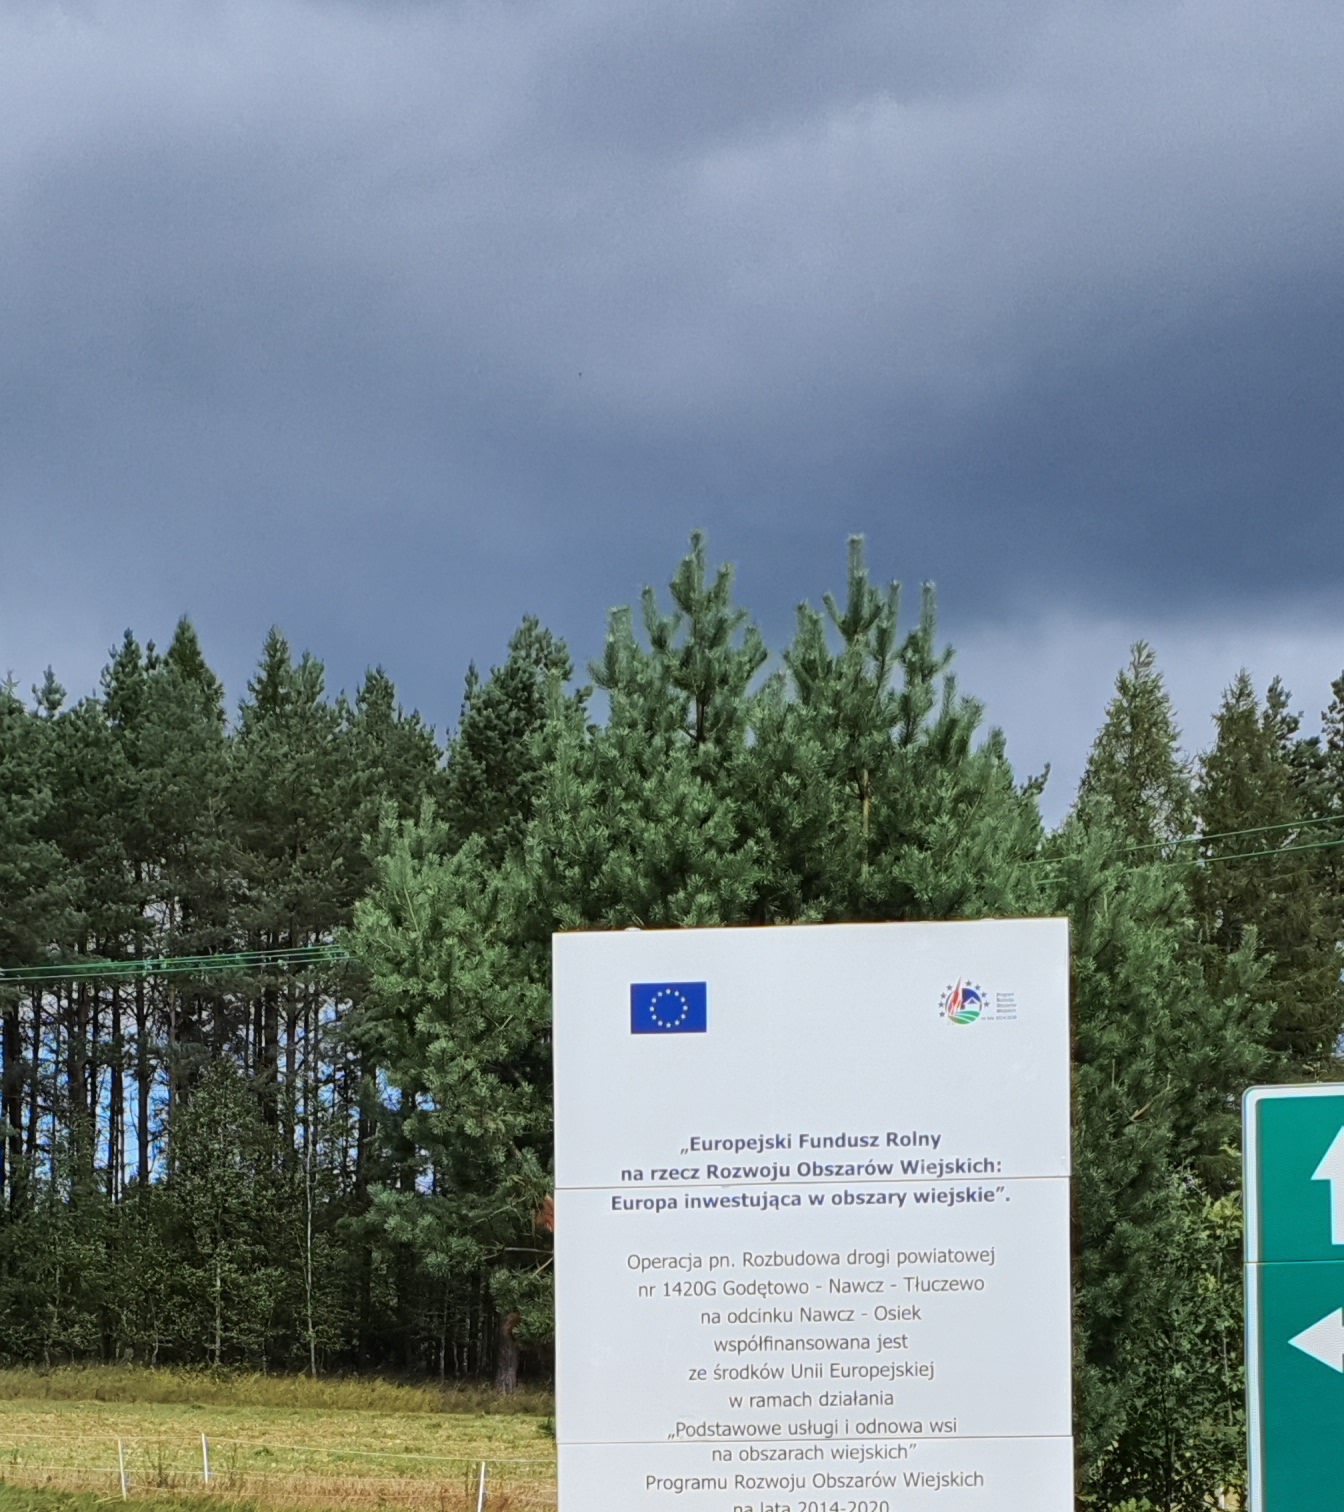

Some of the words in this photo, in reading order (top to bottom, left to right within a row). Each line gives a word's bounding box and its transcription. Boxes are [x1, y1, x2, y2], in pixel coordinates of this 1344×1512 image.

[798, 1131, 880, 1150] Fundusz
[886, 1130, 942, 1151] Rolny
[621, 1168, 644, 1182] na
[650, 1167, 701, 1181] rzecz
[706, 1161, 791, 1182] Rozwoju
[796, 1158, 895, 1178] Obszarów
[899, 1156, 1003, 1177] Wiejskich:
[611, 1195, 678, 1214] Europa
[684, 1190, 802, 1212] inwestująca
[807, 1193, 826, 1206] w
[831, 1189, 908, 1209] obszary
[627, 1252, 703, 1274] Operacja
[709, 1255, 735, 1272] pn.
[742, 1249, 841, 1268] Rozbudowa
[846, 1248, 890, 1269] drogi
[896, 1246, 995, 1267] powiatowej
[638, 1285, 657, 1298] nr
[663, 1280, 717, 1297] 1420G
[722, 1278, 810, 1300] Godętowo
[829, 1277, 885, 1294] Nawcz
[902, 1275, 985, 1293] Tłuczewo
[700, 1311, 721, 1325] na
[727, 1306, 793, 1324] odcinku
[799, 1306, 855, 1323] Nawcz
[873, 1304, 923, 1322] Osiek
[713, 1334, 871, 1356] współfinansowana
[875, 1333, 909, 1353] jest
[688, 1368, 708, 1381] ze
[713, 1362, 785, 1381] środków
[791, 1362, 823, 1380] Unii
[829, 1360, 935, 1382] Europejskiej
[728, 1396, 743, 1409] w
[749, 1390, 813, 1409] ramach
[818, 1389, 894, 1407] działania
[787, 1418, 841, 1440] usługi
[855, 1417, 923, 1435] odnowa
[929, 1416, 957, 1434] wsi
[711, 1449, 733, 1462] na
[738, 1444, 825, 1462] obszarach
[645, 1474, 728, 1495] Programu
[734, 1473, 806, 1493] Rozwoju
[812, 1471, 897, 1489] Obszarów
[902, 1470, 985, 1492] Wiejskich
